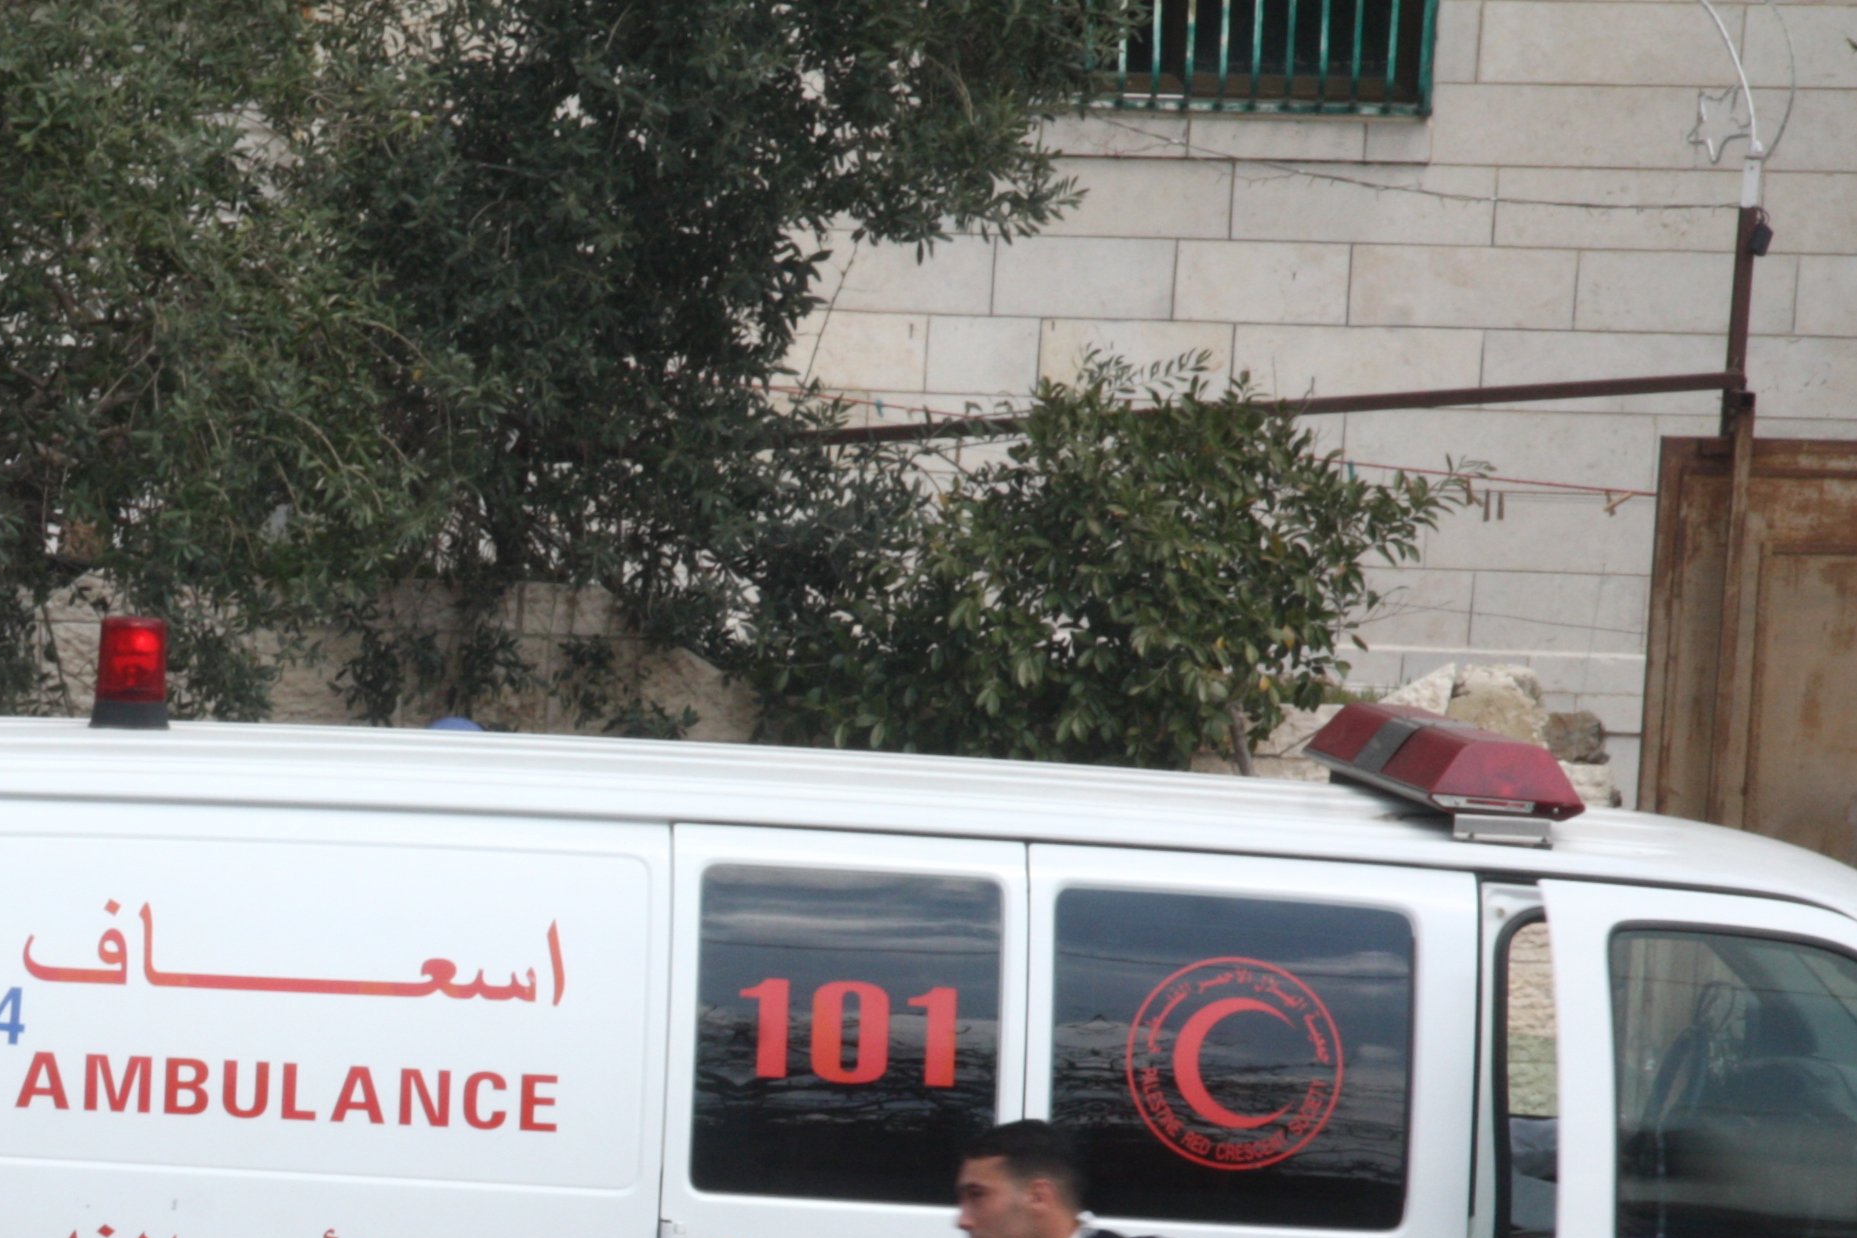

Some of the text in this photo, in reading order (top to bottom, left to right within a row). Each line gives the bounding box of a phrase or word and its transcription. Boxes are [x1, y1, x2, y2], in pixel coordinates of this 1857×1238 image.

[22, 898, 565, 1007] اسعاف
[739, 977, 959, 1088] 101
[14, 1050, 559, 1133] AMBULANCE
[1141, 1066, 1329, 1160] PALESTINE RED CRESCENT SOCIETY
